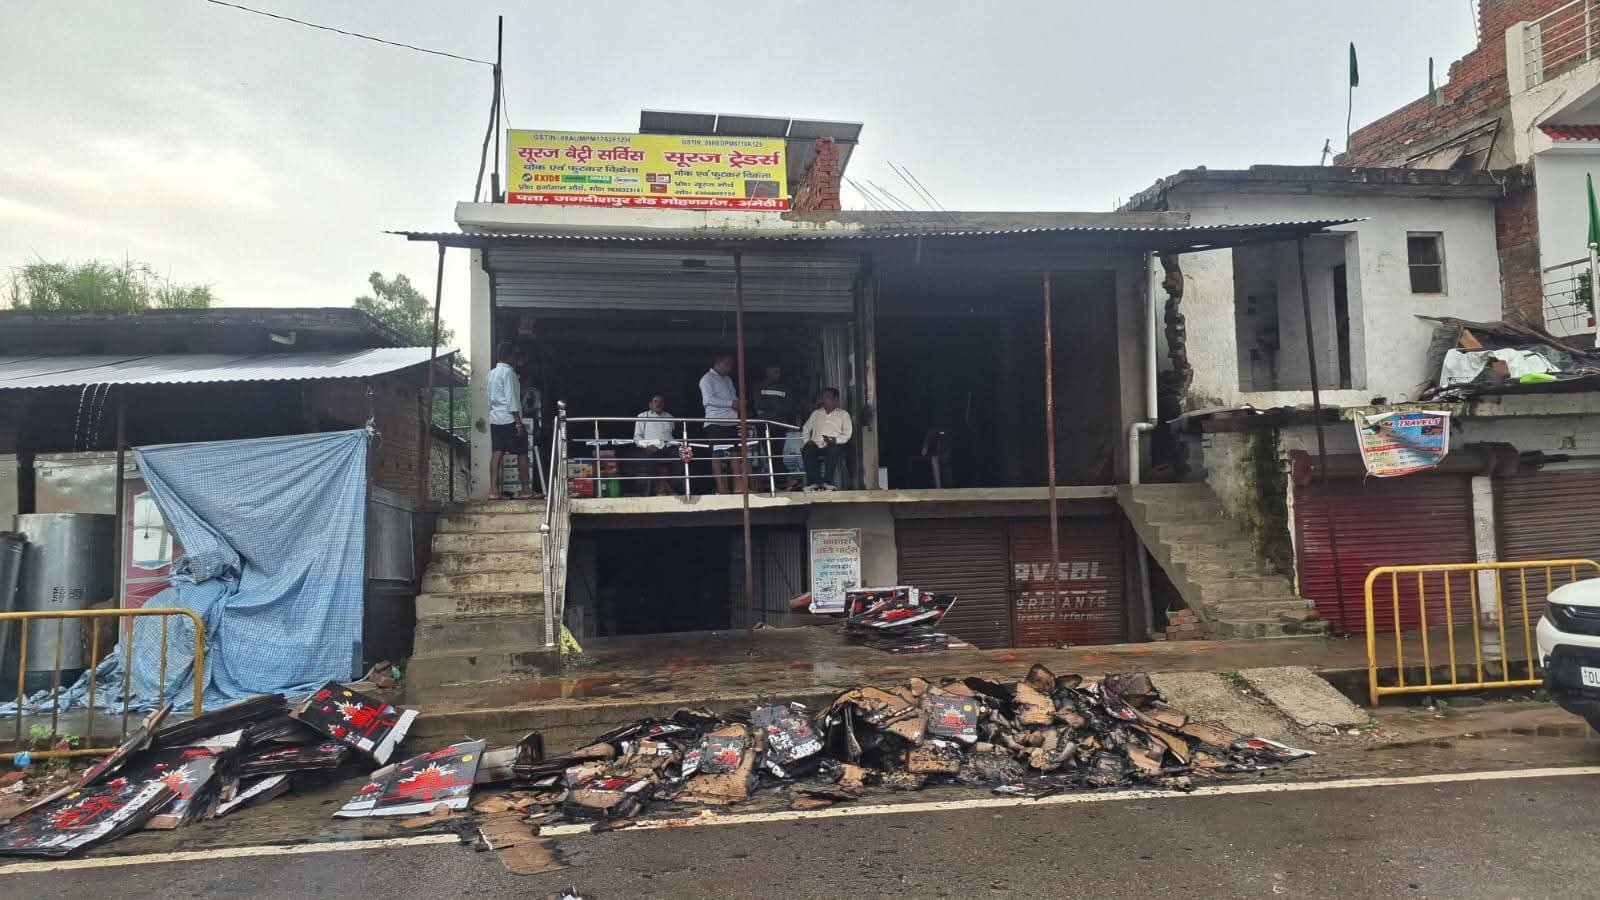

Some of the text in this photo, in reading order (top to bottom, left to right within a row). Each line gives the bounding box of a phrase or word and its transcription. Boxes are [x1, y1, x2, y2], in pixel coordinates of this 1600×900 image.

[518, 147, 560, 163] सूरज
[597, 146, 645, 161] सर्विस
[664, 152, 721, 168] सूरज
[533, 174, 560, 182] EXIDE
